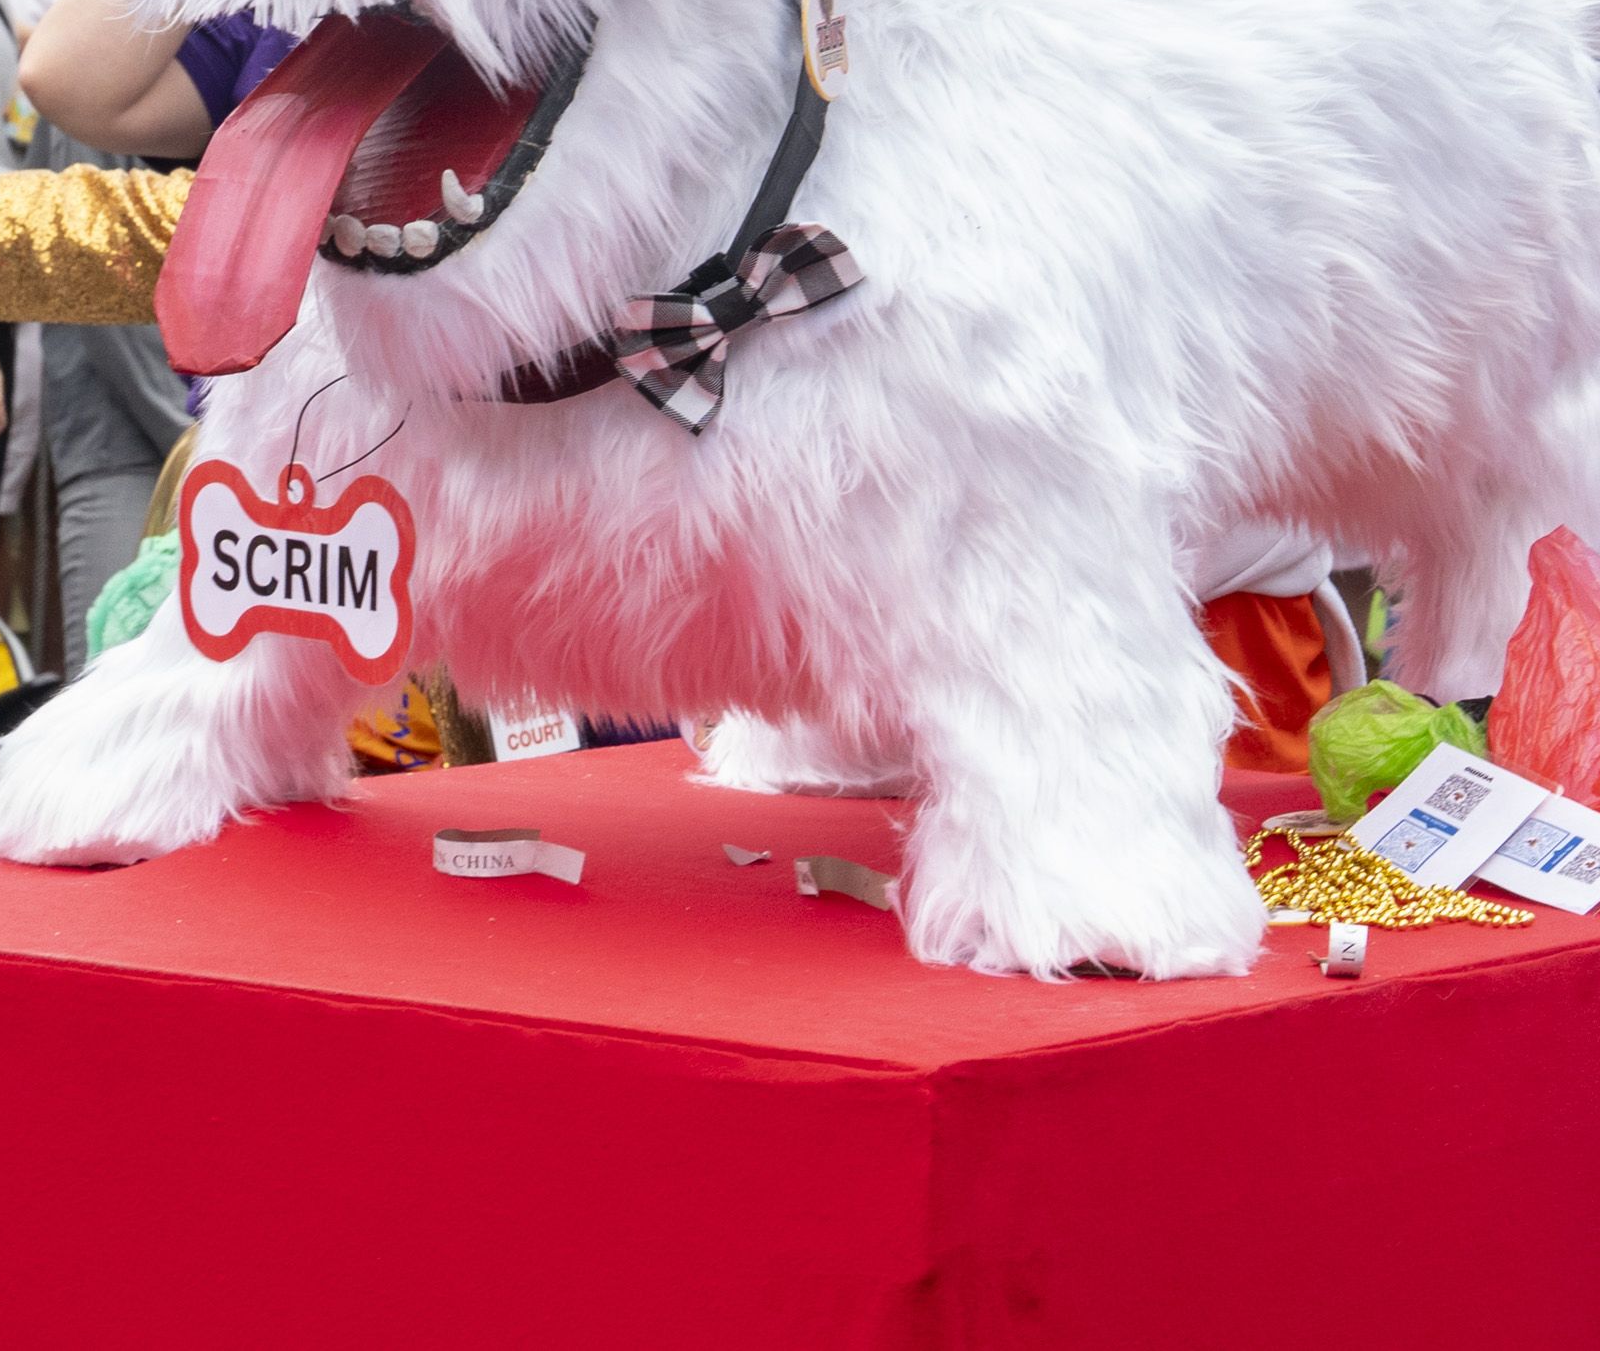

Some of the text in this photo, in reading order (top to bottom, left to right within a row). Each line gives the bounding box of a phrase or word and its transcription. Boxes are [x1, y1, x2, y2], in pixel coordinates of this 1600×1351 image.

[212, 529, 379, 612] SCRIM
[507, 720, 565, 751] COURT
[452, 854, 516, 869] CHINA
